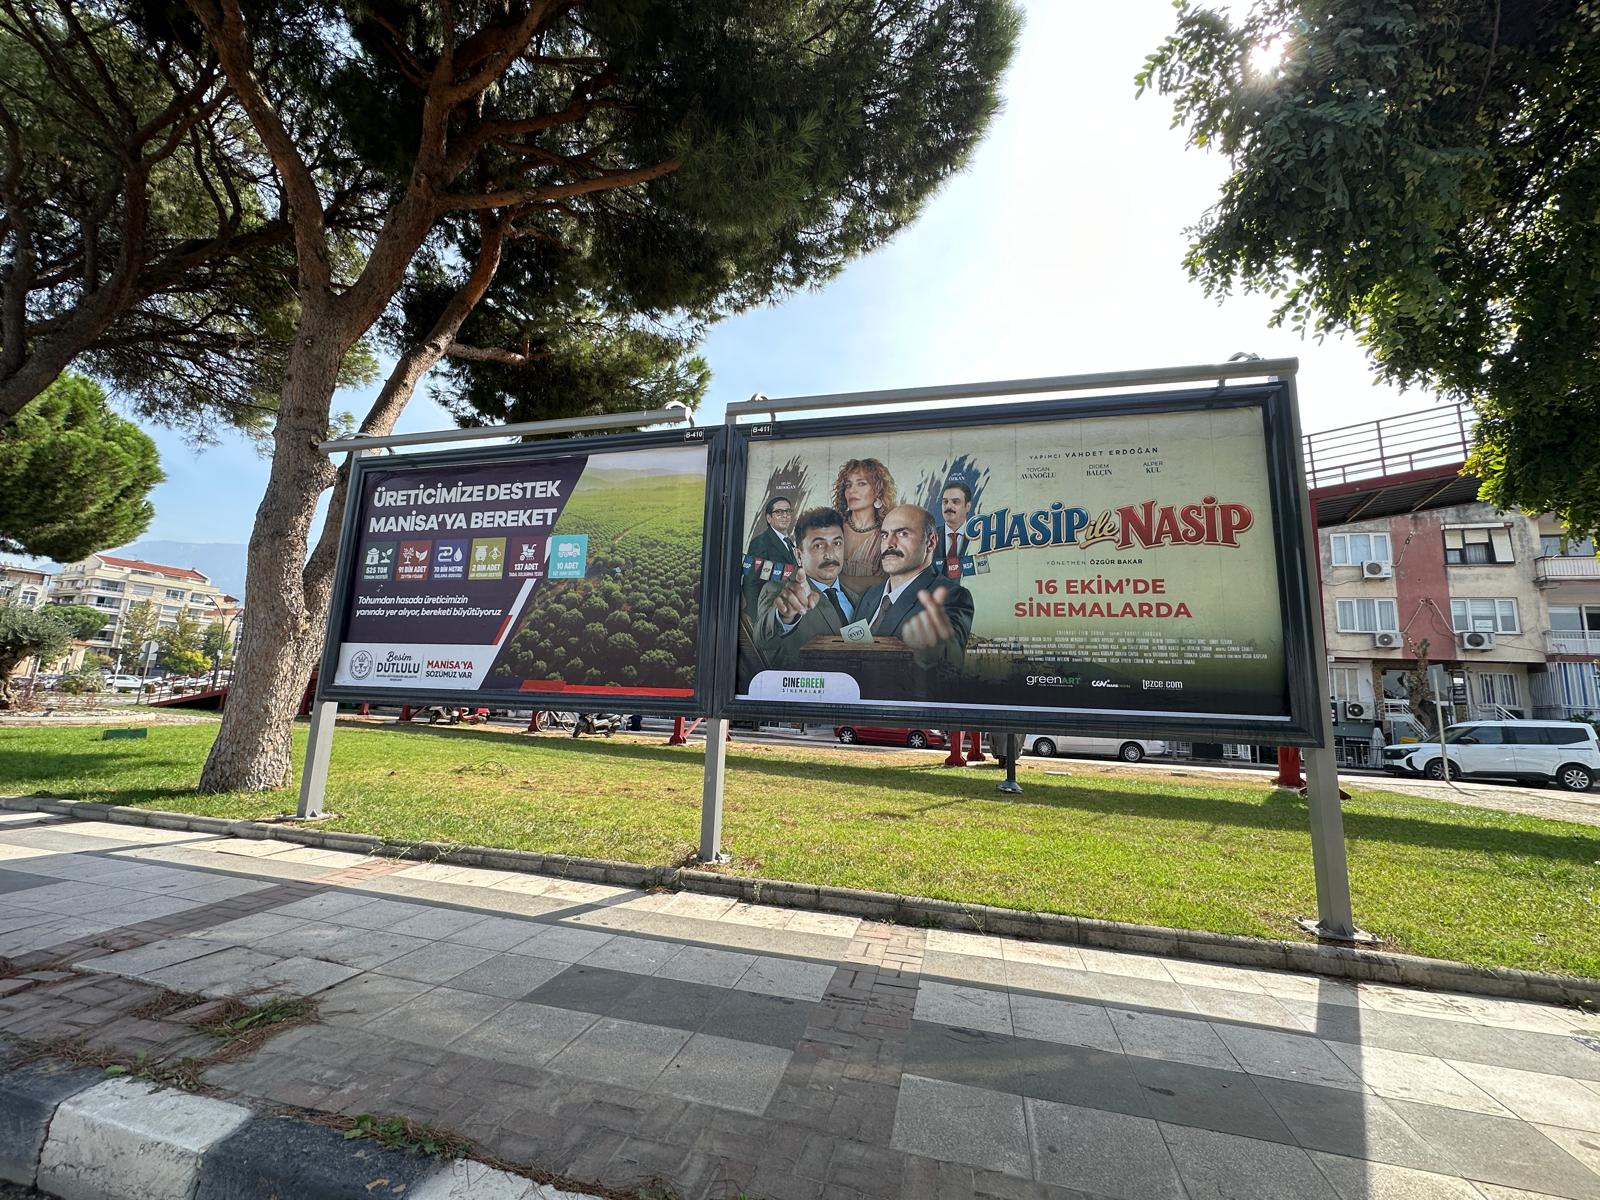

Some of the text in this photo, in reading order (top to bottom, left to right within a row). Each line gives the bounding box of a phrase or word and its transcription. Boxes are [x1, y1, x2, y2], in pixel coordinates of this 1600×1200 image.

[1065, 450, 1104, 458] VAHDET
[1109, 446, 1159, 456] ERDOĞAN
[373, 480, 562, 507] ÜRETİCİMİZE DESTEK
[368, 507, 558, 532] MANİSA'YA BEREKET
[965, 495, 1254, 556] HASİP ile NASİP
[487, 563, 501, 571] ADET
[514, 562, 539, 571] 137 ADET
[1089, 558, 1115, 566] ÖZGÜR
[1035, 574, 1166, 595] 16 EKİM'DE
[358, 594, 469, 605] Tohumdan hasada üreticimizin
[356, 608, 385, 617] yanında
[385, 609, 398, 618] yer
[421, 607, 452, 616] bereketi
[452, 607, 503, 618] büyütüyoruz
[1014, 596, 1193, 619] SİNEMALARDA
[387, 651, 412, 662] Besim
[376, 662, 420, 674] DUTLULU
[458, 671, 473, 679] VAR
[1142, 679, 1183, 690] tezce.com
